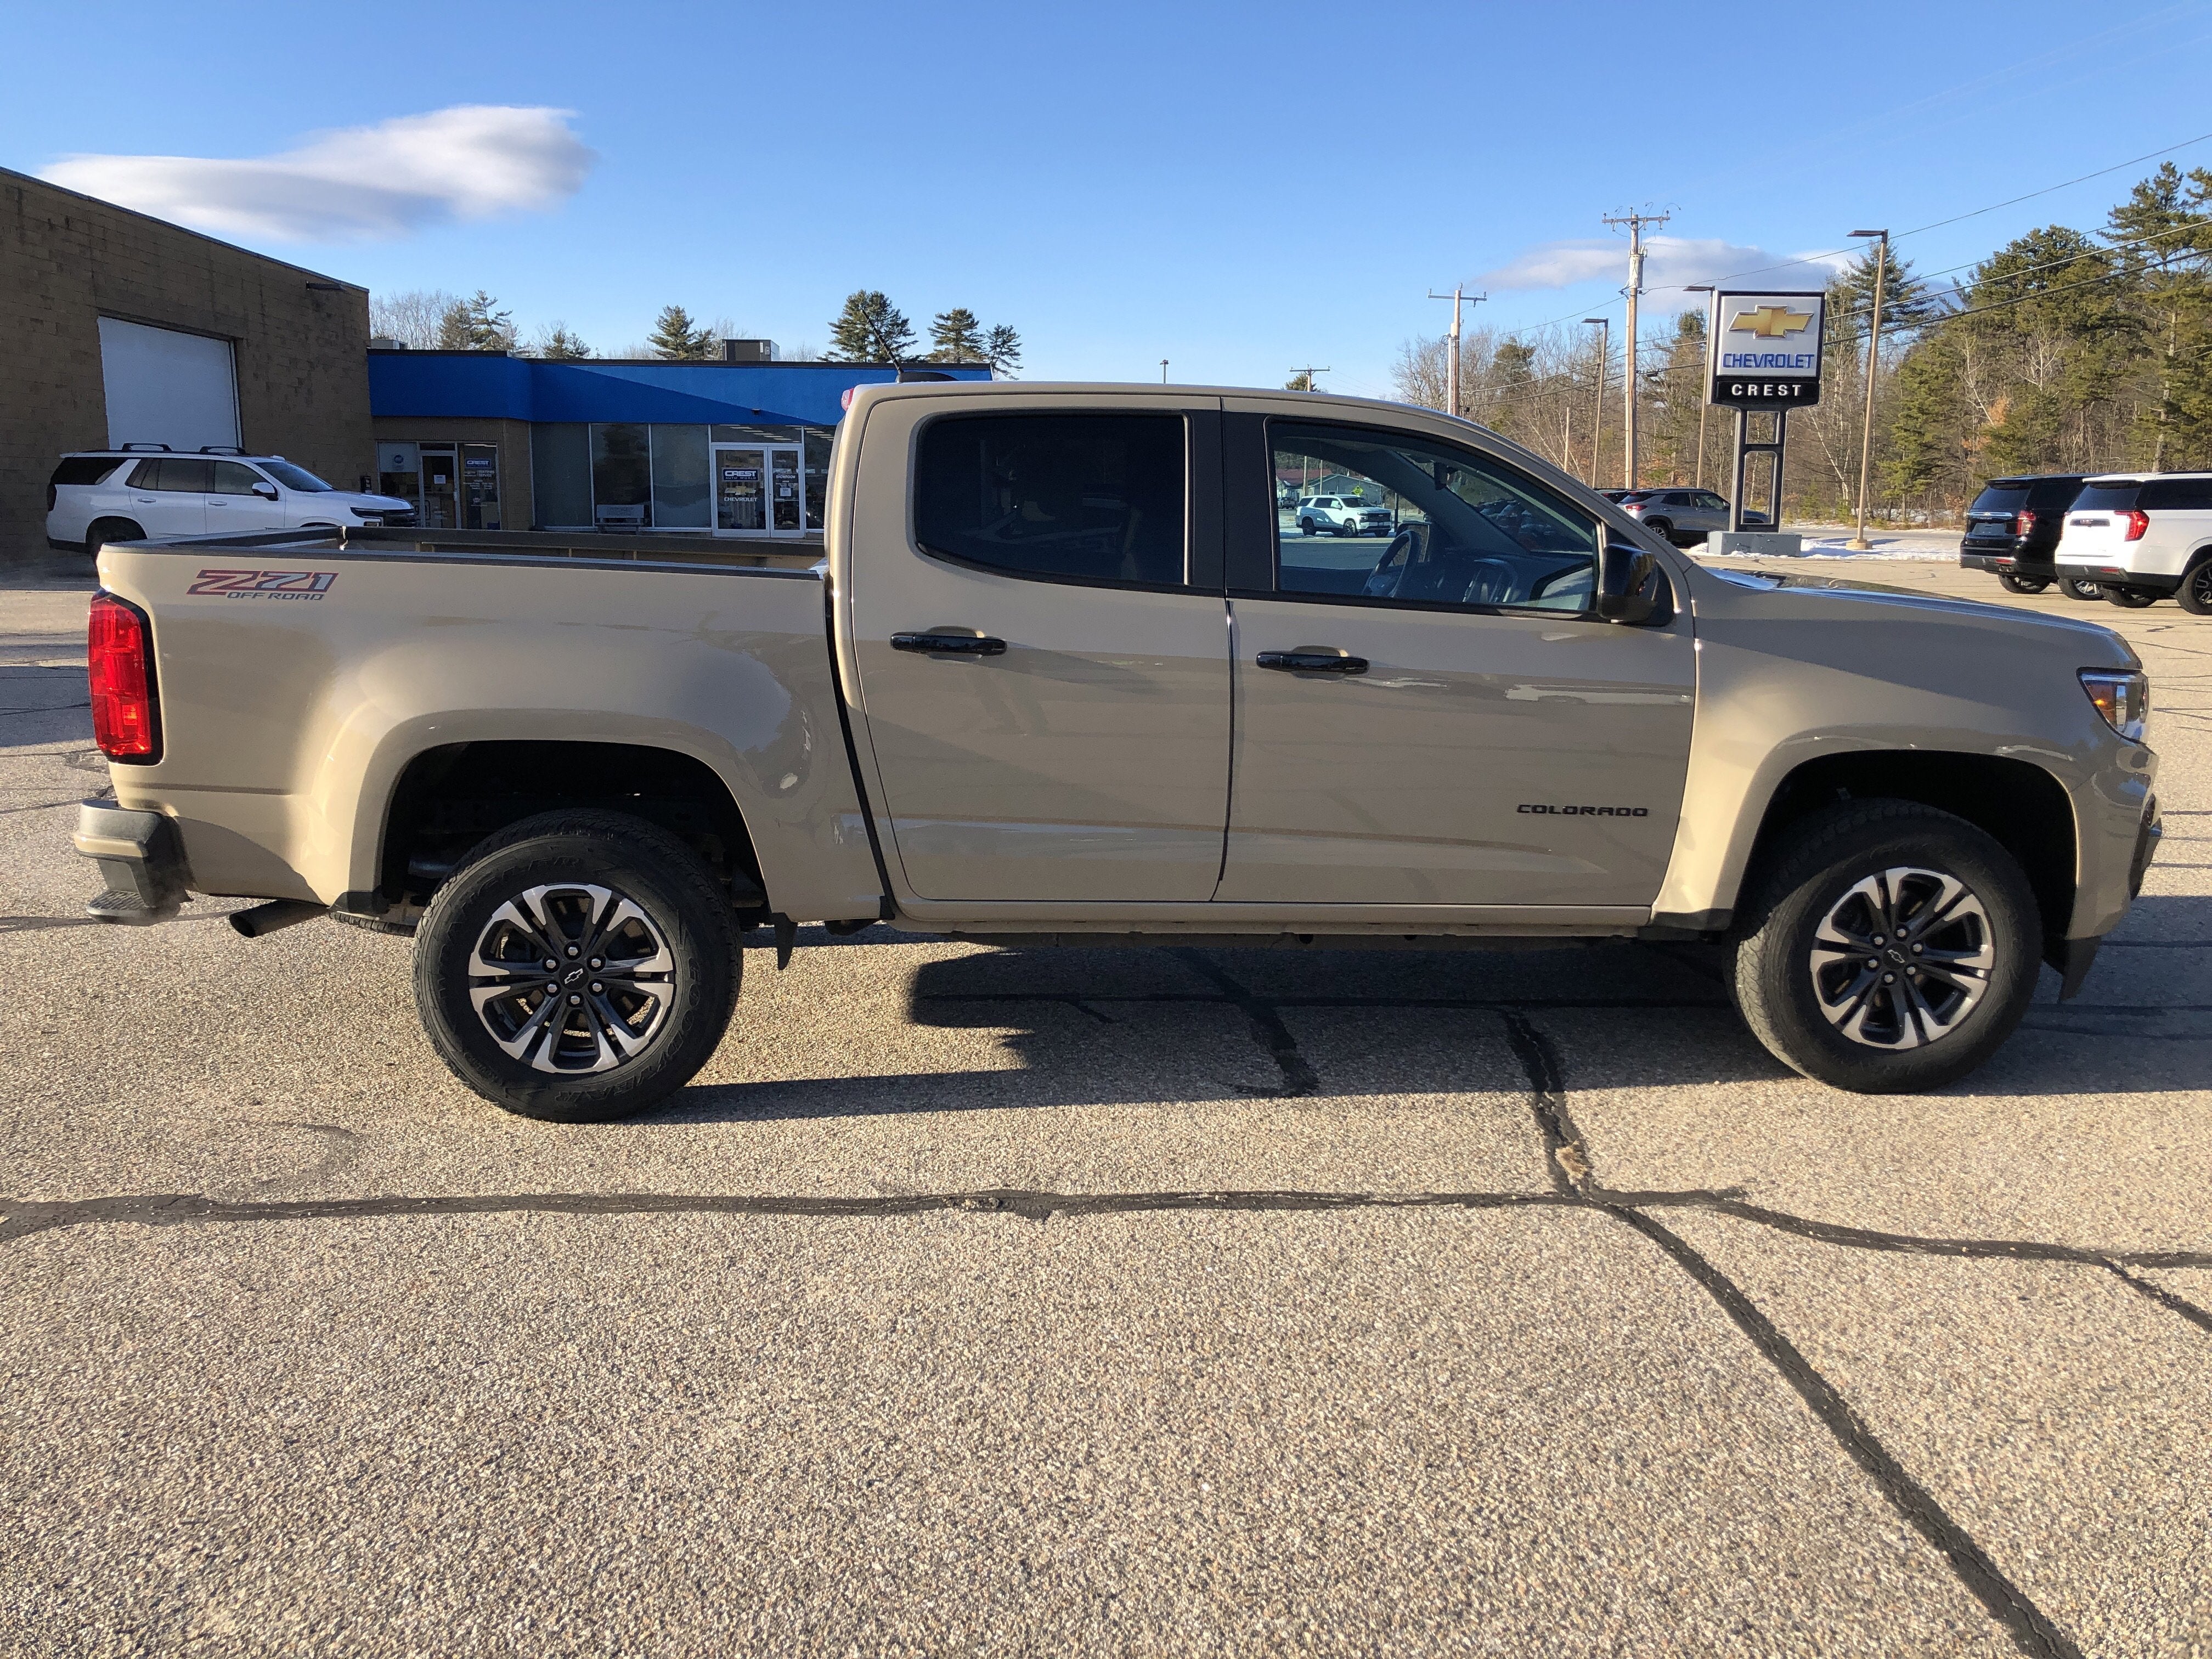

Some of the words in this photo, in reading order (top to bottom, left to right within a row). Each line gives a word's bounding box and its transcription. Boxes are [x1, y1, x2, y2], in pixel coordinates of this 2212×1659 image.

[1723, 353, 1815, 369] CHEVROLET
[1731, 384, 1802, 396] CREST
[186, 569, 338, 595] Z71
[268, 592, 325, 601] ROAD
[1516, 804, 1647, 817] COLORADO
[554, 957, 701, 1102] GOODYEAR
